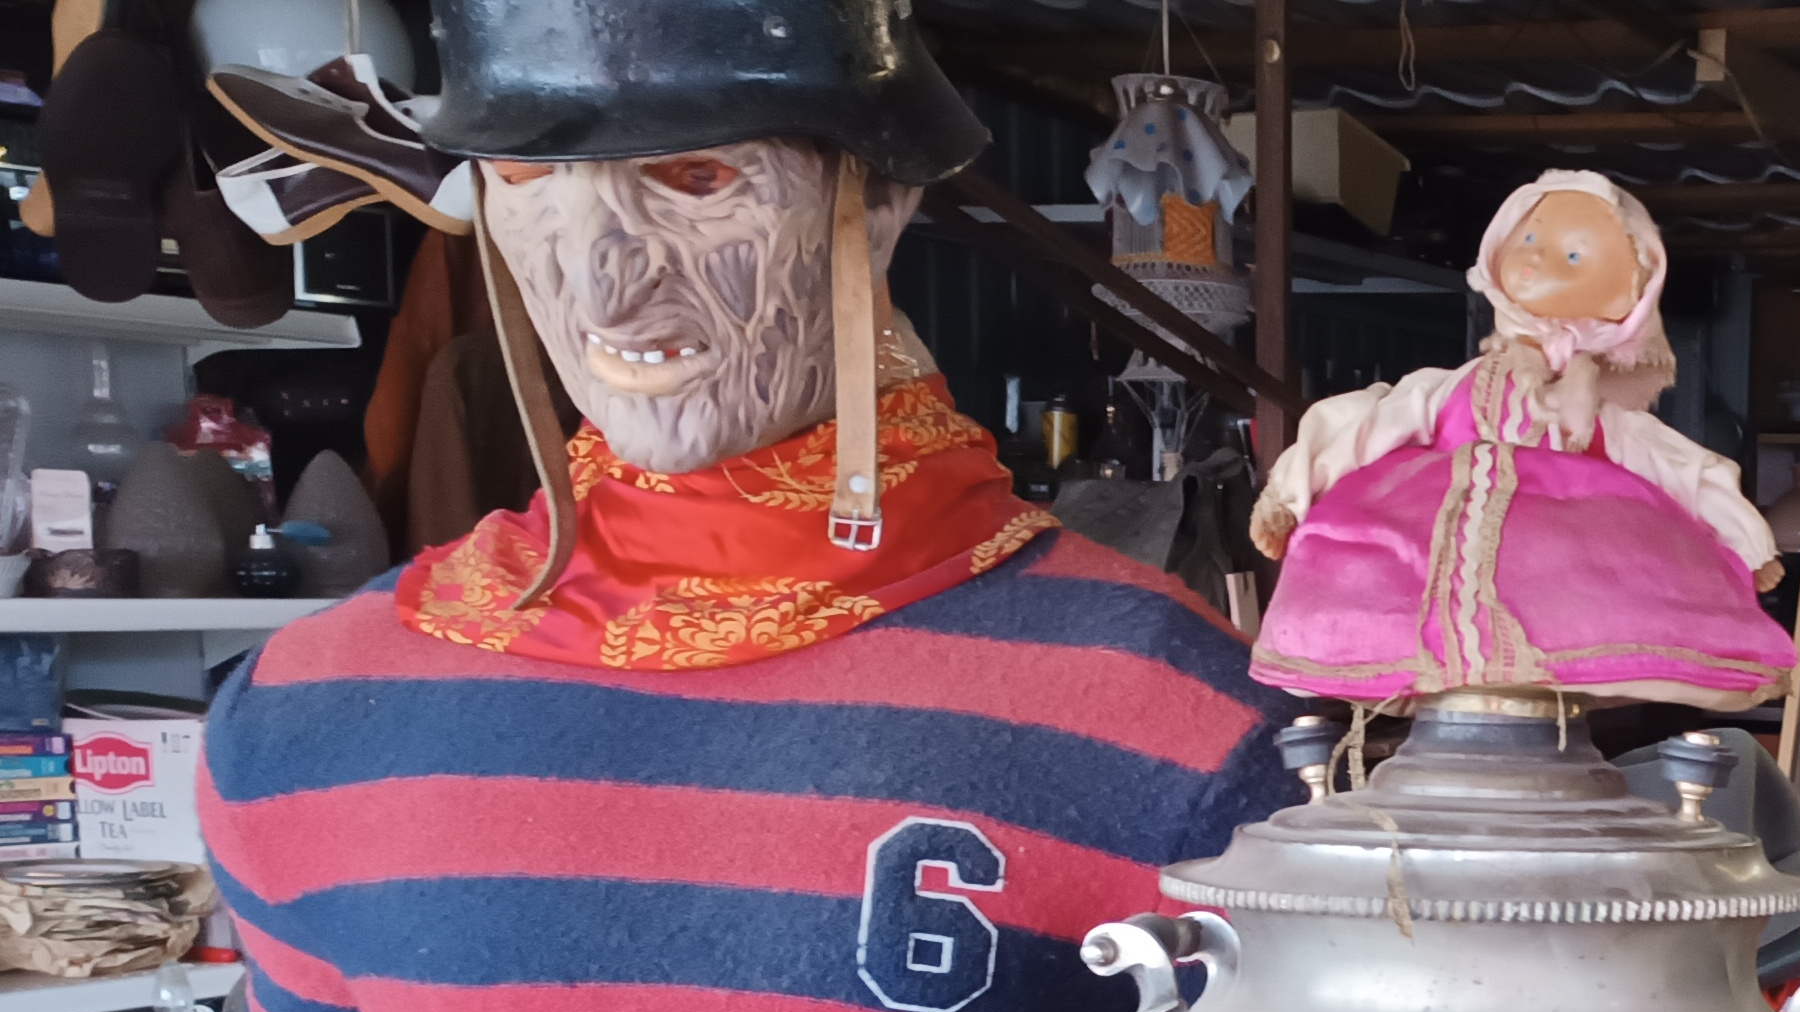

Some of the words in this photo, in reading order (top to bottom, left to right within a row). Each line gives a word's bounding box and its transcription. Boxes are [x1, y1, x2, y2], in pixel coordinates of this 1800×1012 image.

[74, 749, 146, 780] Lipton
[122, 800, 167, 821] LABEL
[99, 821, 128, 839] TEA
